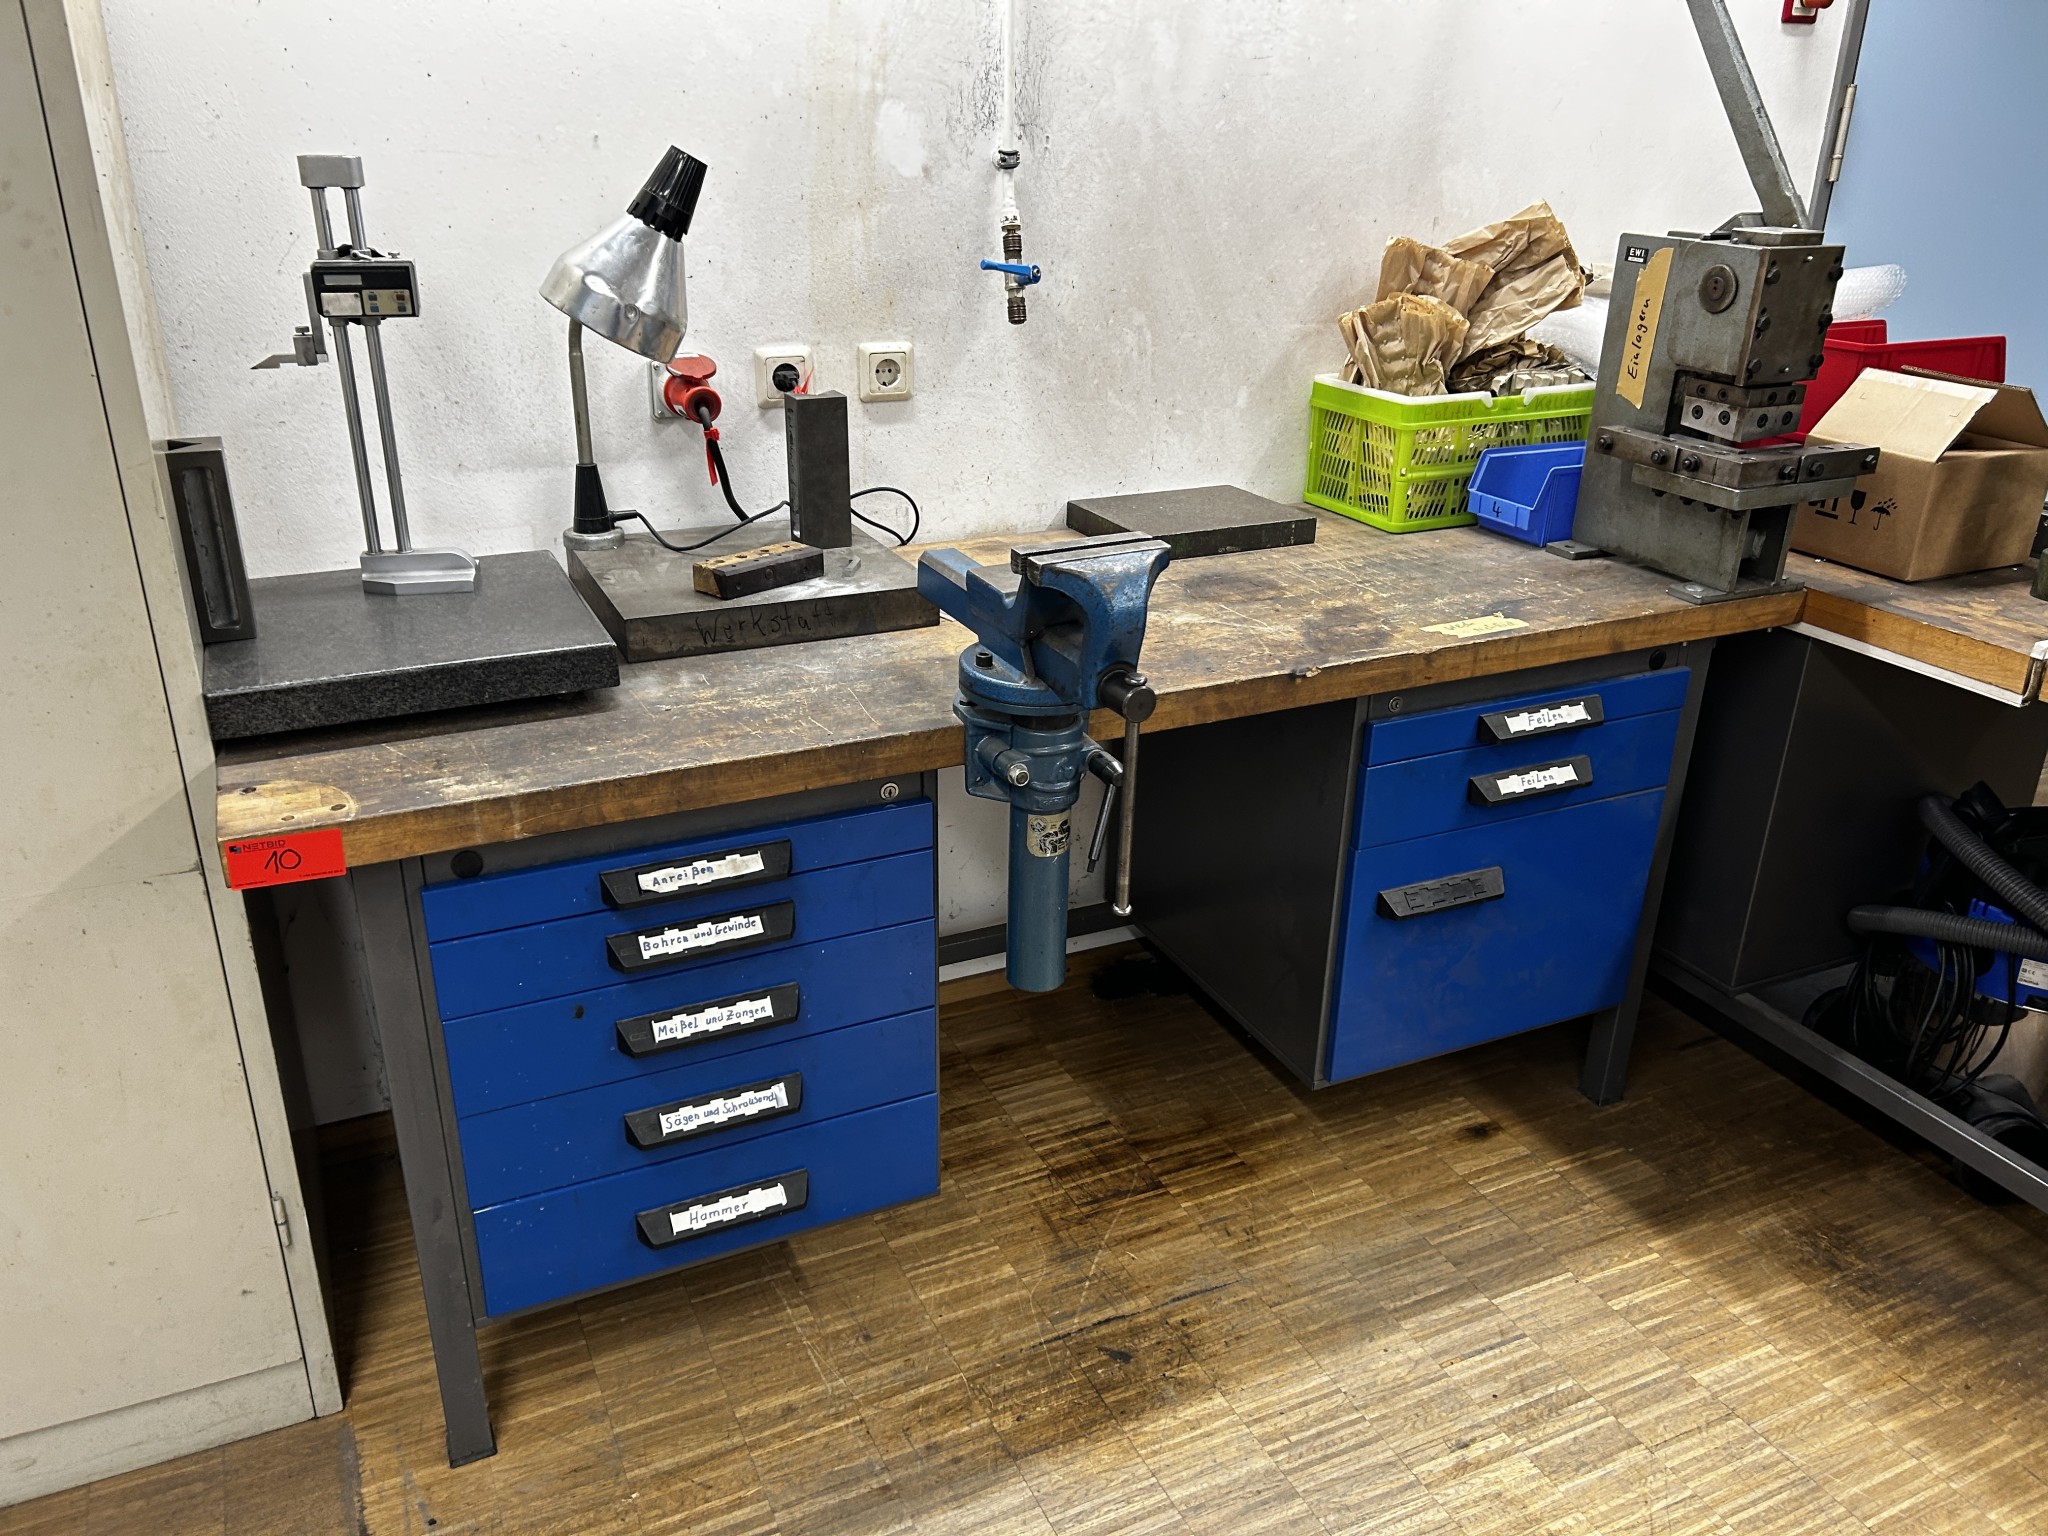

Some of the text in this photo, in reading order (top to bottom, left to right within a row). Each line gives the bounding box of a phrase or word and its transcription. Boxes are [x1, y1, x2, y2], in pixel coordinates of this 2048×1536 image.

[1491, 500, 1502, 518] 4
[243, 839, 285, 851] NETBID
[264, 848, 301, 873] 10
[643, 918, 757, 952] Bohren und Gewinde
[705, 1011, 724, 1026] und
[726, 1005, 767, 1021] Zangen
[665, 1113, 700, 1130] Sägen
[704, 1106, 720, 1118] und
[689, 1200, 749, 1225] Hammer
